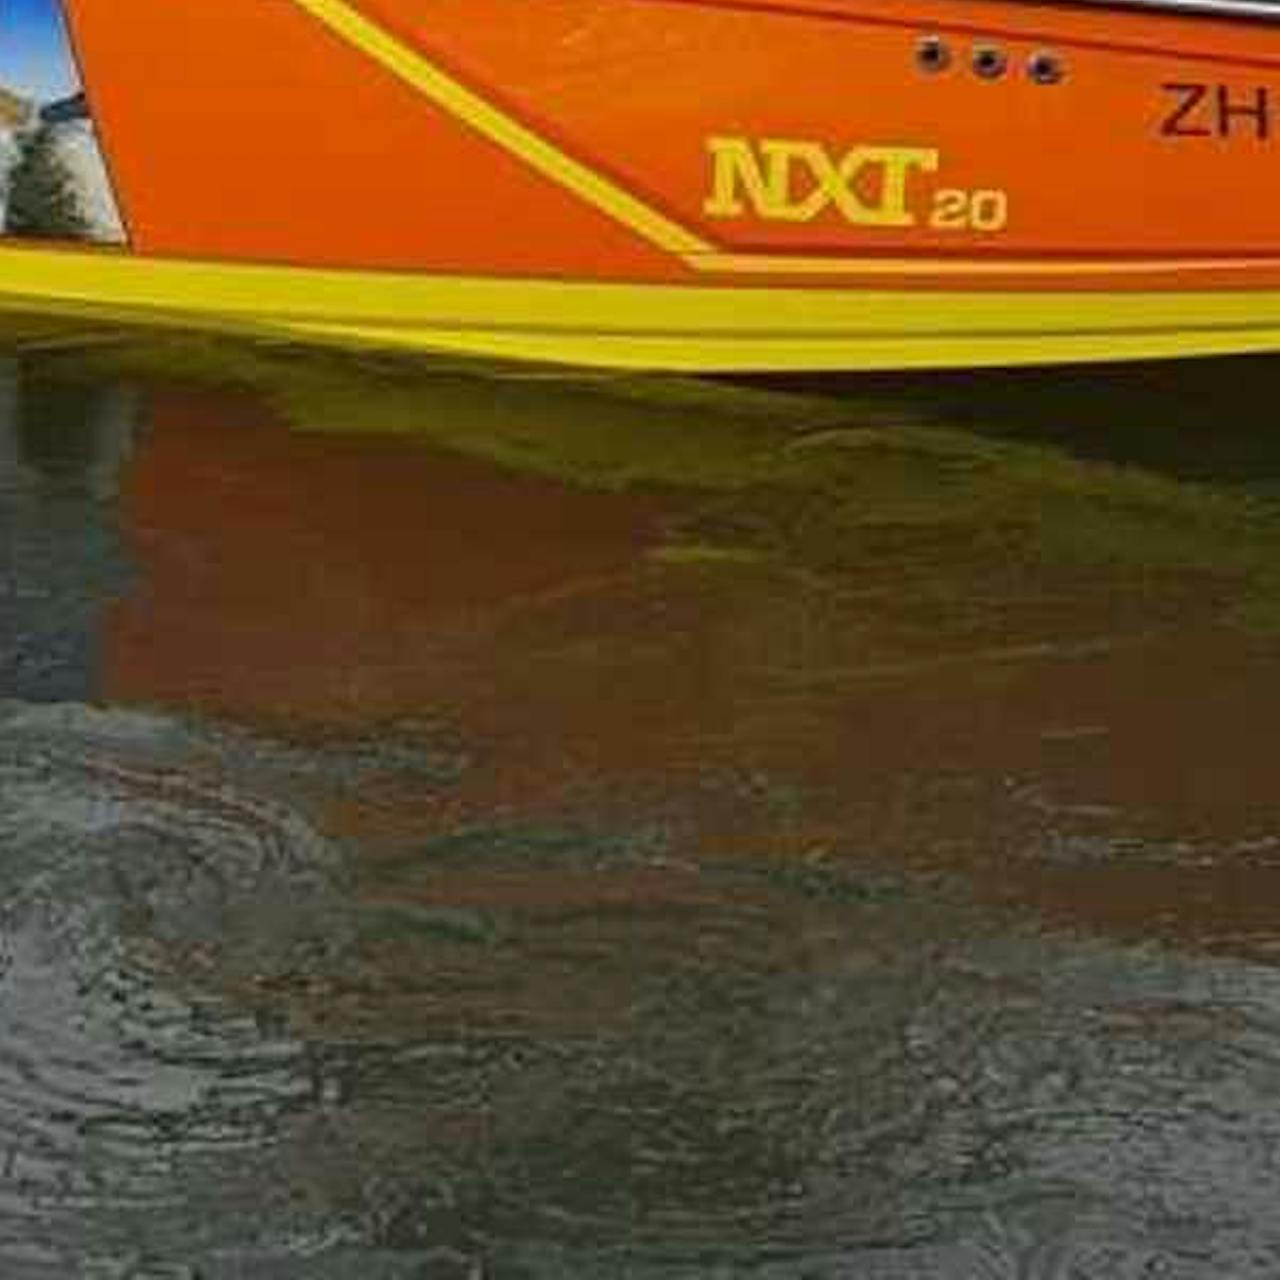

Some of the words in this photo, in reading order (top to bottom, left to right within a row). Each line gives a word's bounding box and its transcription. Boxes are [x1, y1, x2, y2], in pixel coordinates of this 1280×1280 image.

[1160, 83, 1269, 141] ZH
[703, 136, 939, 226] NXT
[930, 188, 1009, 231] 20
